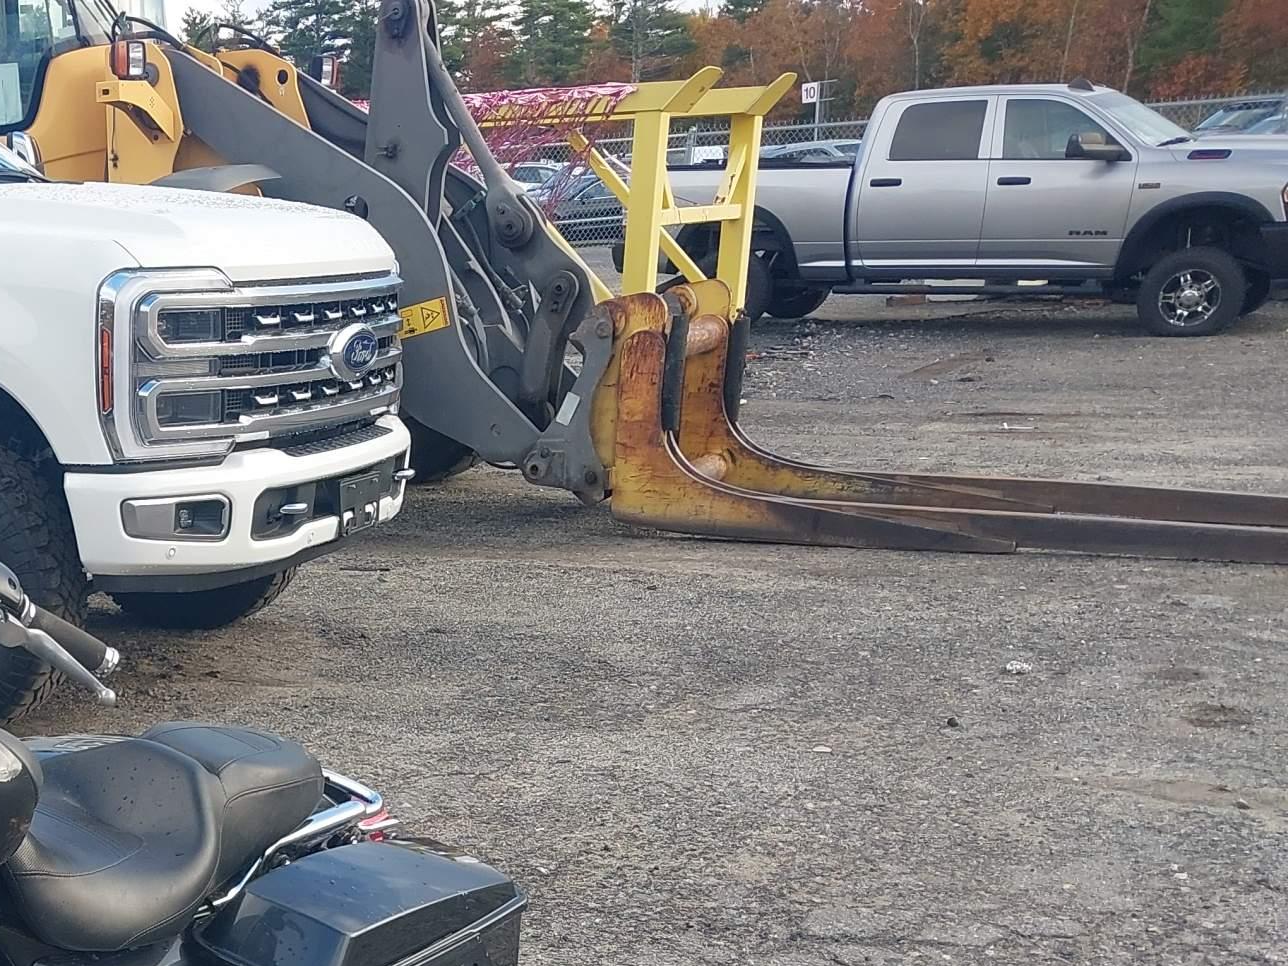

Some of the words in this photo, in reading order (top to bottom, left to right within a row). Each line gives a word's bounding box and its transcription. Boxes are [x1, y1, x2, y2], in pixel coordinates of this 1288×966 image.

[803, 86, 816, 100] 10
[1068, 229, 1108, 237] RAM
[350, 340, 376, 365] Ford
